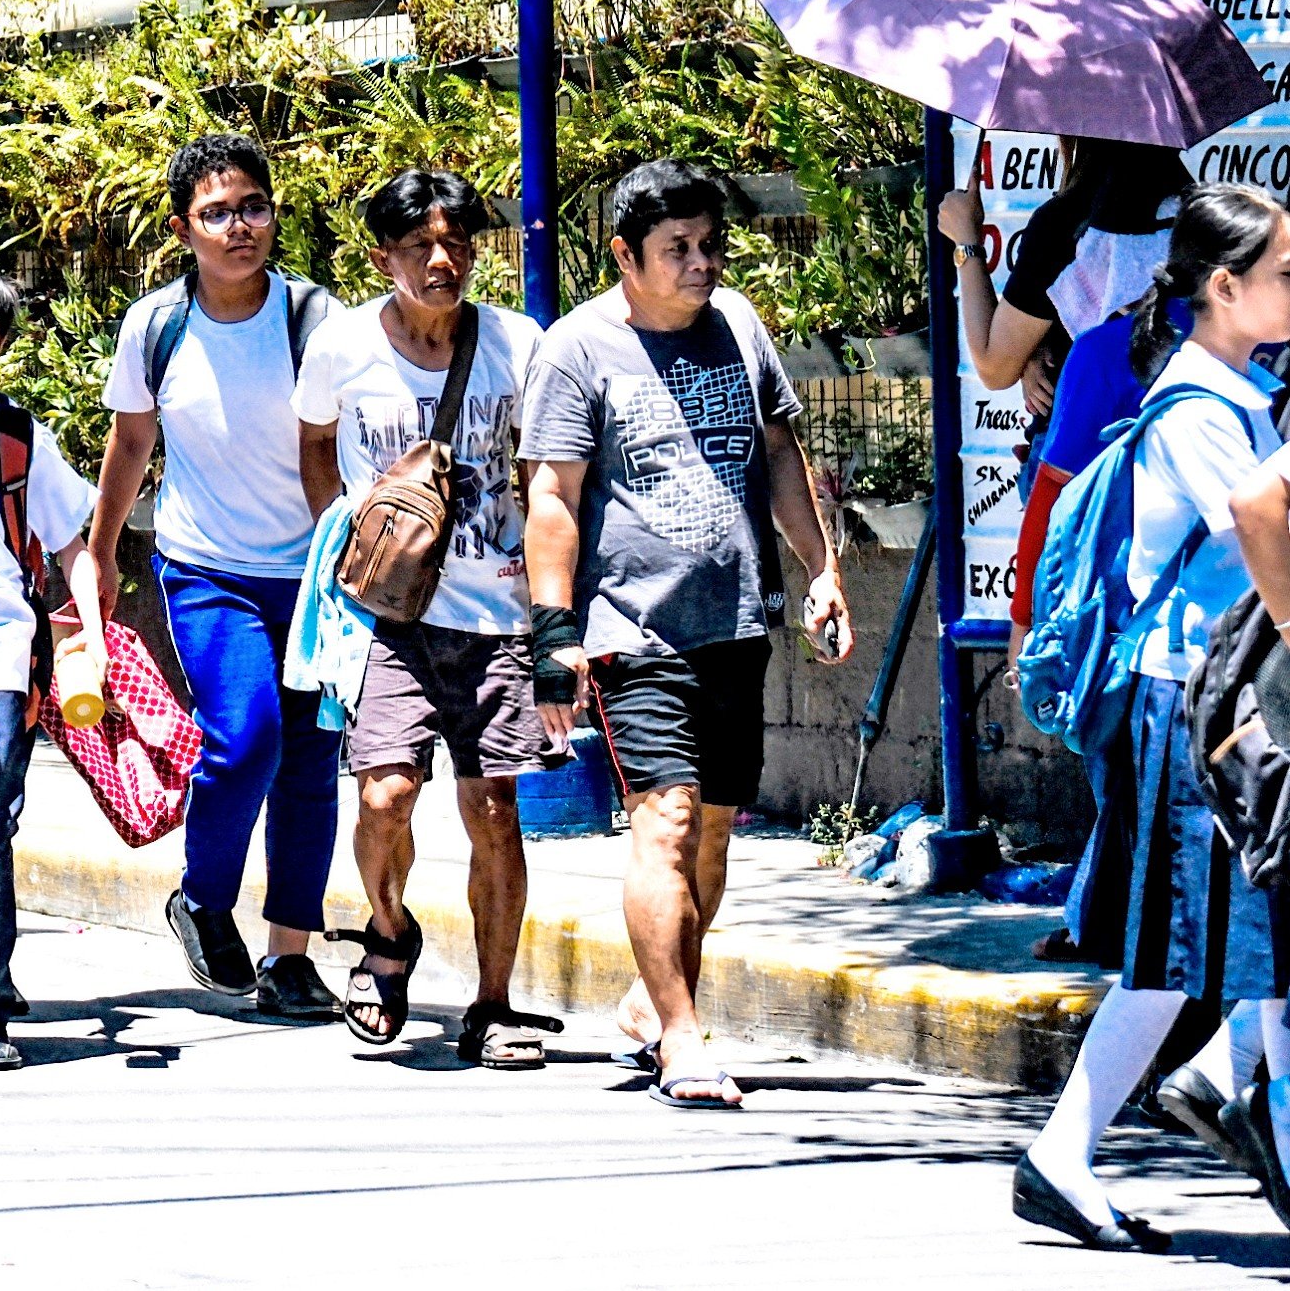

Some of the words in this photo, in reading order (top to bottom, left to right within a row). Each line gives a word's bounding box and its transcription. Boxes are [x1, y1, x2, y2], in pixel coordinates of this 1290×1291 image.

[1198, 144, 1290, 191] CINCO
[647, 390, 730, 422] 883
[628, 435, 751, 472] POLICE
[973, 465, 1004, 487] SK
